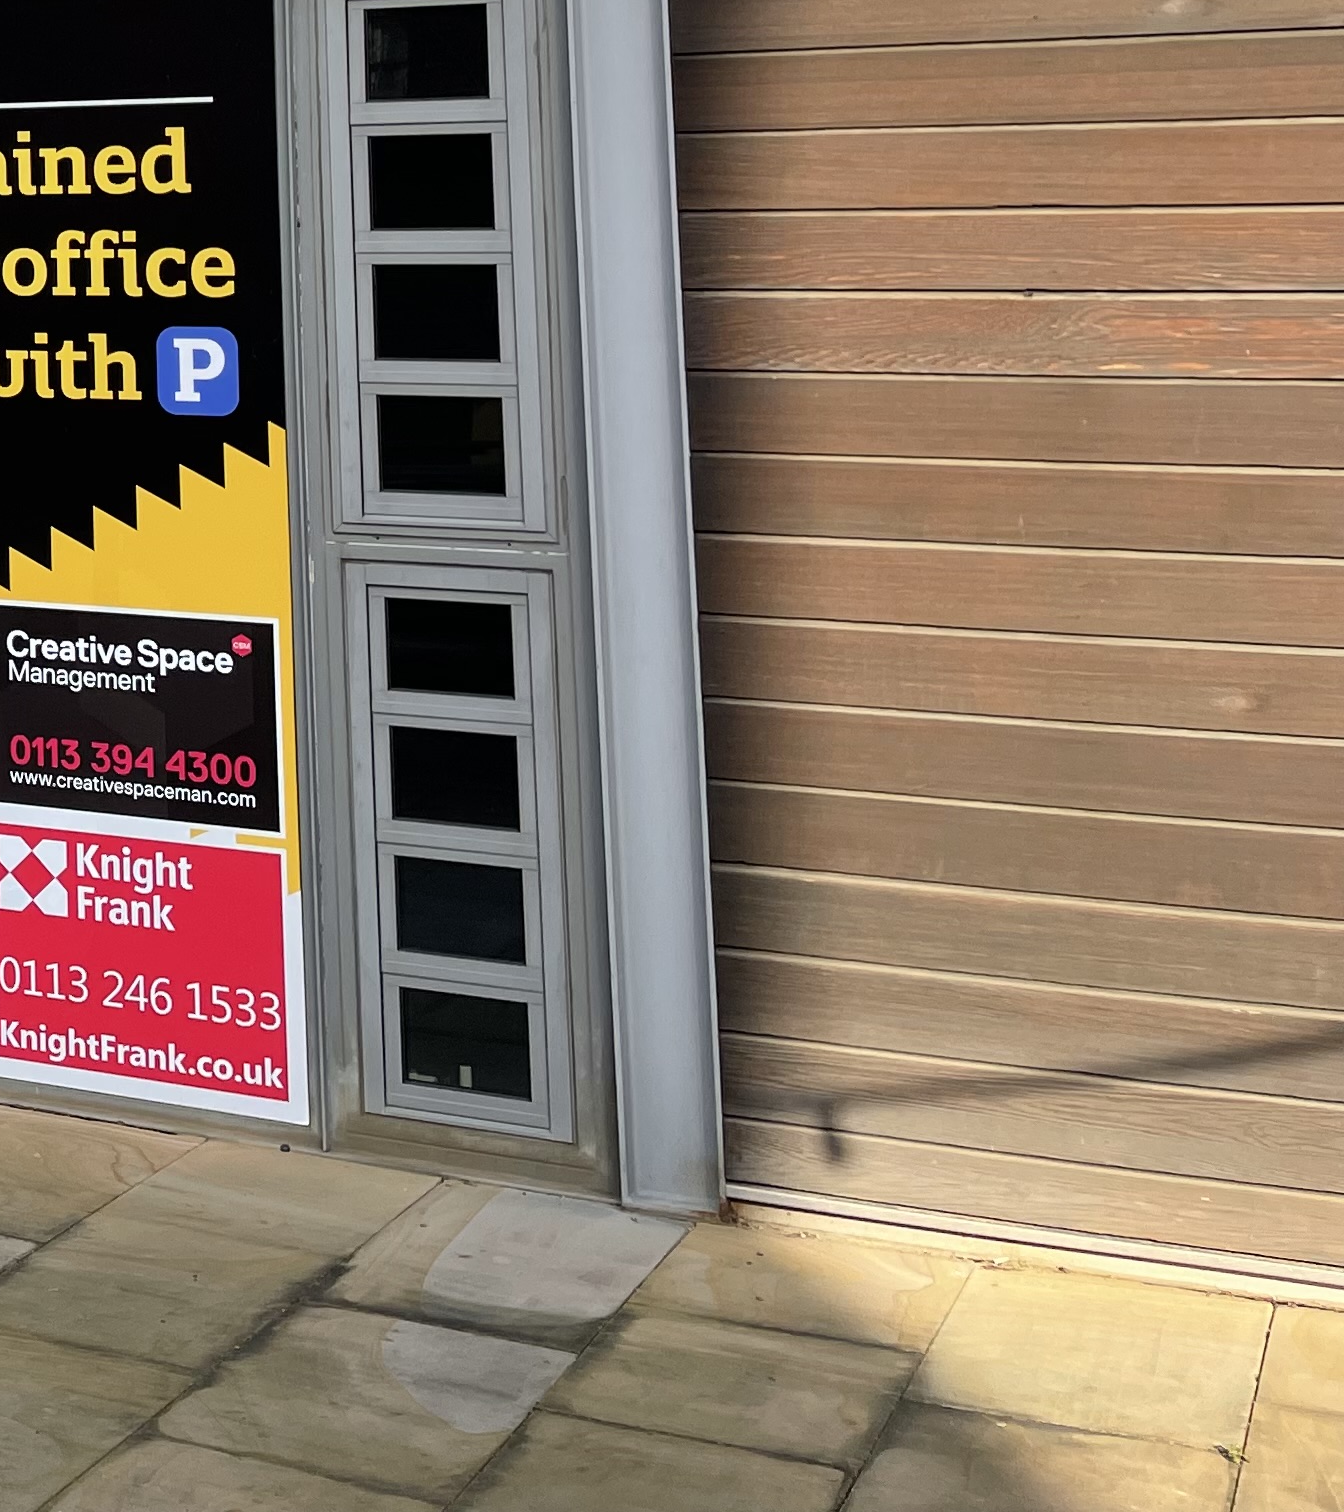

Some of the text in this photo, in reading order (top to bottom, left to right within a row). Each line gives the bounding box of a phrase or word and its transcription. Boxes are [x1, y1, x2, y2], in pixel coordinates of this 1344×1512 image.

[1, 229, 236, 298] office
[6, 629, 234, 676] Creative Space
[7, 660, 156, 693] Management
[10, 734, 257, 788] 0113 394 4300
[9, 771, 256, 808] www.creativespaceman.com
[76, 842, 193, 892] Knight
[77, 886, 176, 931] Frank
[0, 956, 281, 1031] 0113 246 1533
[0, 1019, 284, 1089] KnightFrank.co.uk
